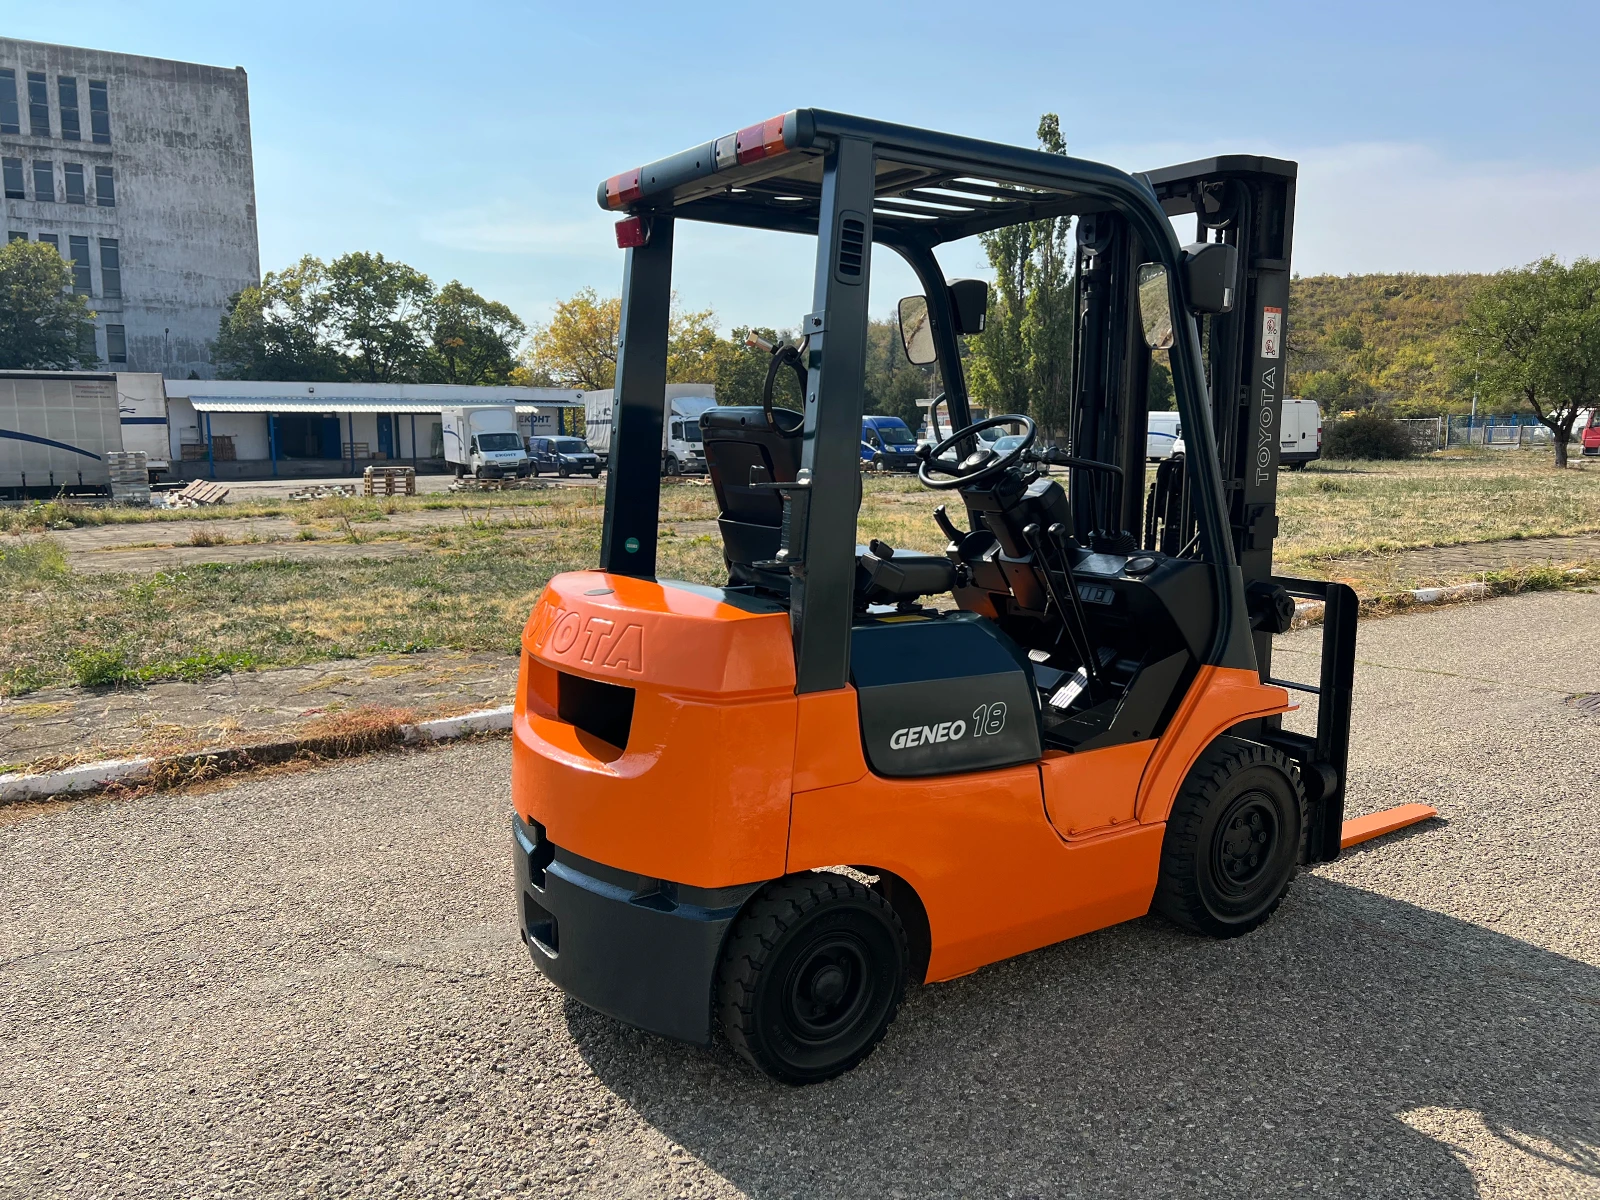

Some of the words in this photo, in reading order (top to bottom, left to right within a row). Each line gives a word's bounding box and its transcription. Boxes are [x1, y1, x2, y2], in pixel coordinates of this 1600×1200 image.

[1255, 366, 1276, 487] TOYOTA
[525, 597, 644, 675] OYOTA
[889, 719, 967, 750] GENEO
[972, 701, 1007, 737] 18
